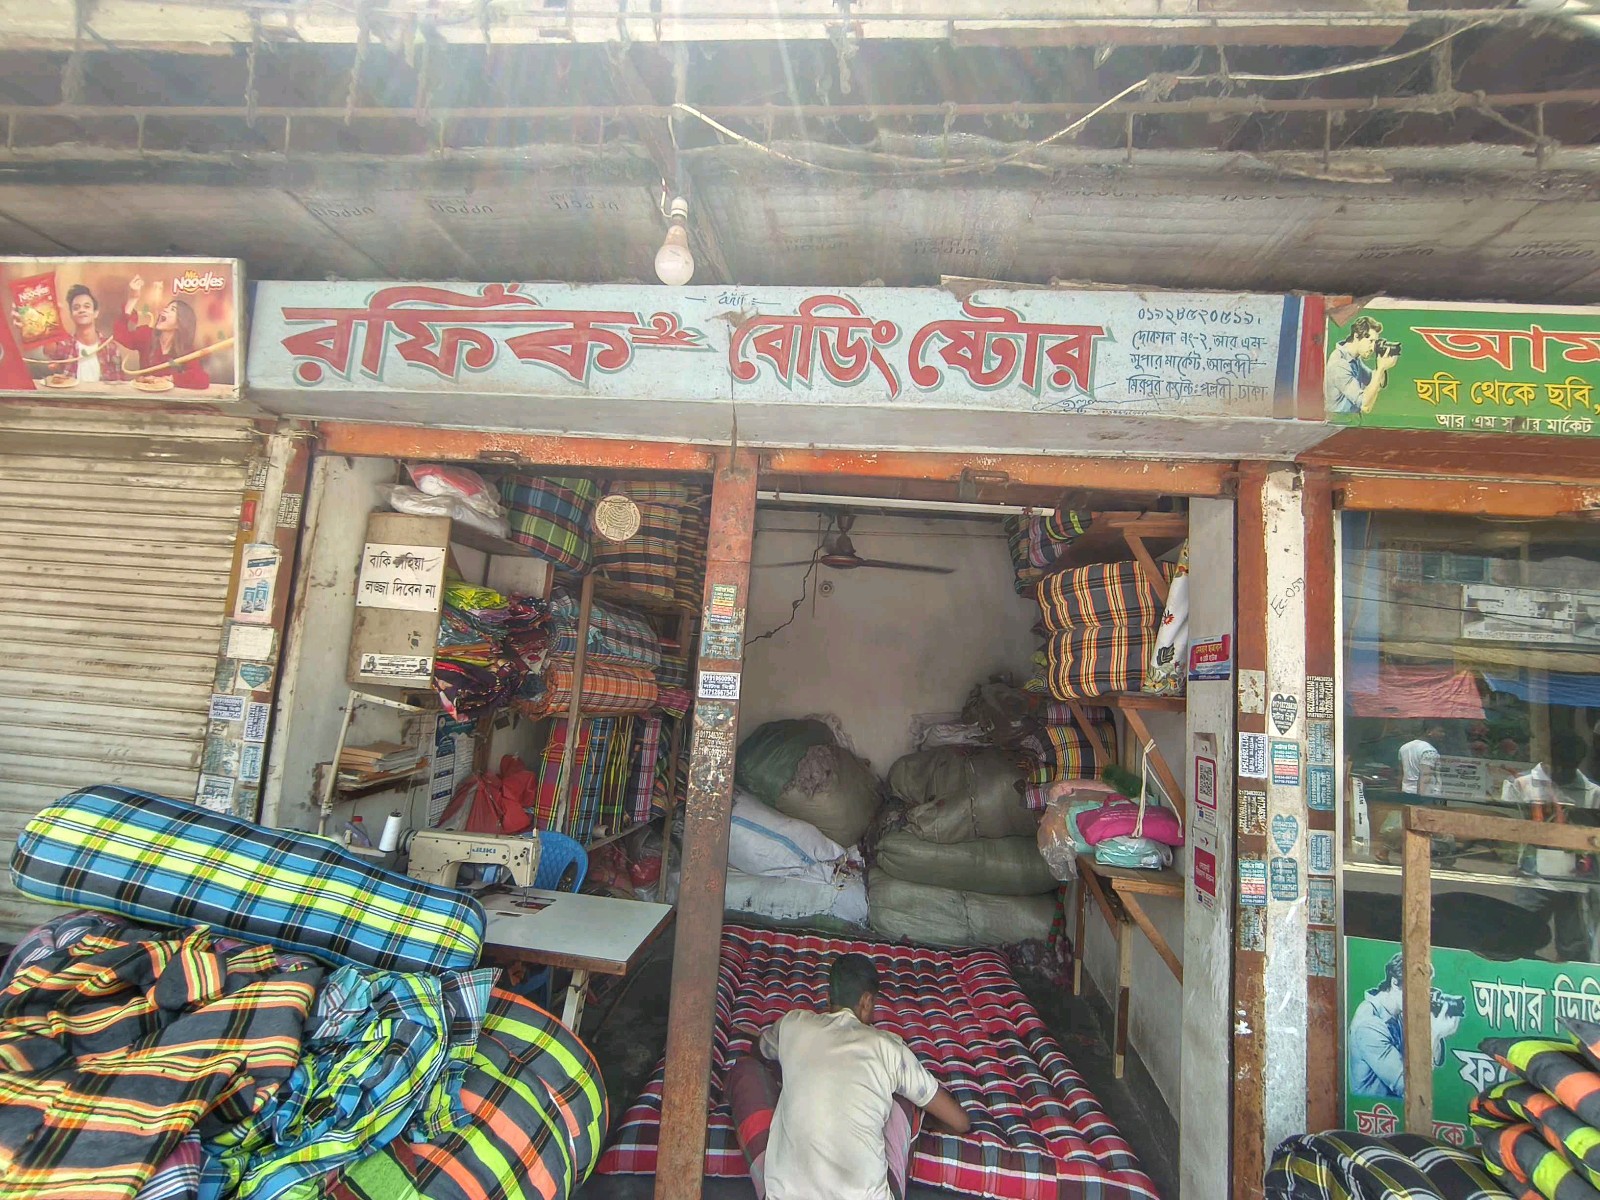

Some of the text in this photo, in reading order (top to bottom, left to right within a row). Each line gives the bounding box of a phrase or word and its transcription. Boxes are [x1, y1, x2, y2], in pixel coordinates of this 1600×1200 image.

[172, 271, 225, 294] Noodles
[281, 283, 642, 386] রফিক
[731, 294, 898, 398] বেডিং
[1132, 330, 1176, 350] দোকান
[1213, 334, 1238, 350] আর
[1414, 371, 1460, 405] ছবি
[1470, 379, 1538, 406] থেকে
[1436, 414, 1465, 428] আর
[1501, 416, 1541, 432] সুার
[1547, 415, 1593, 433] মার্কেট
[370, 551, 391, 569] বাকি
[365, 577, 436, 599] লজ্জা দিবেন না
[1471, 976, 1547, 1034] আমার
